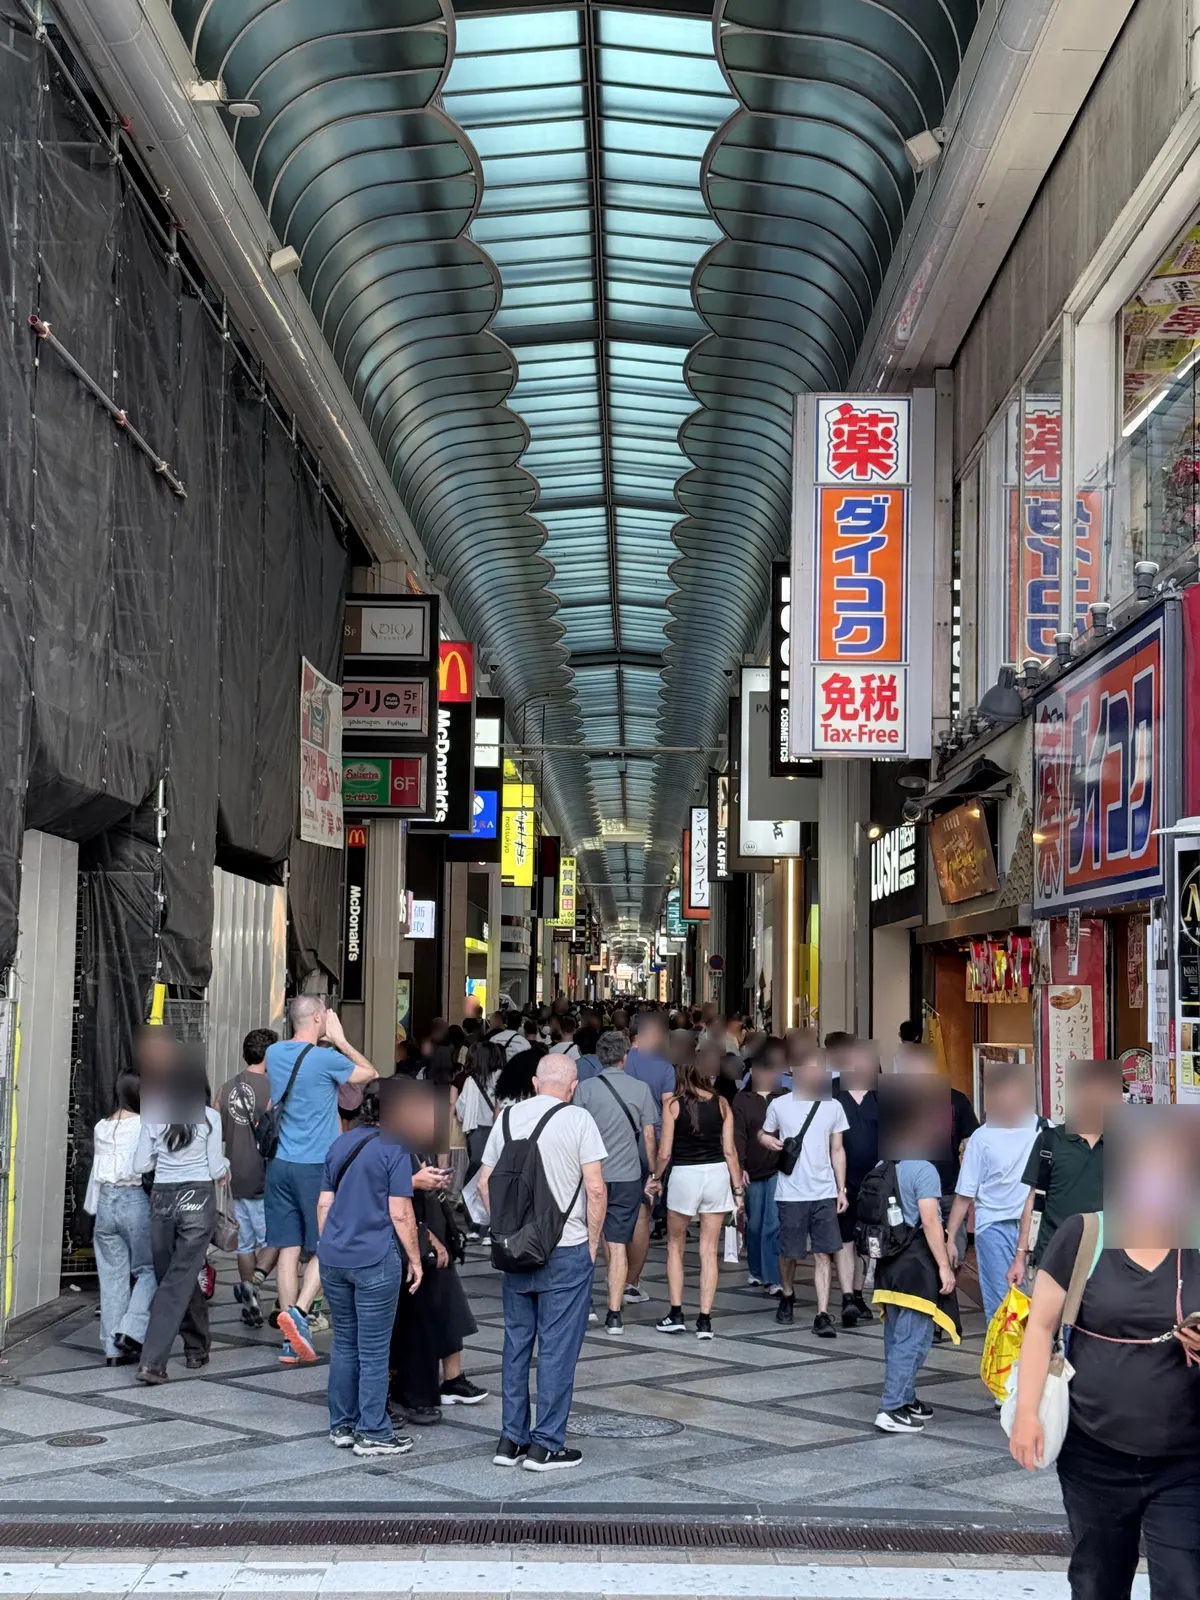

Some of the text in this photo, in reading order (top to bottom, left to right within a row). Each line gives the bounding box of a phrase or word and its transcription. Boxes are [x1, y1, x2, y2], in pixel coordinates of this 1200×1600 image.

[824, 403, 899, 480] 薬
[833, 495, 889, 656] ダイコク
[344, 625, 356, 636] 8F
[343, 688, 380, 712] プリ
[404, 690, 417, 700] 5F
[404, 704, 417, 714] 7F
[821, 672, 899, 723] 免税
[780, 708, 789, 763] COSMETICS
[821, 724, 899, 743] Tax-Free
[394, 777, 416, 791] 6F
[435, 709, 451, 822] McDonald's
[345, 793, 378, 801] サイゼリヤ
[694, 811, 707, 903] ジャパンライフ
[717, 841, 728, 877] CAFFÉ
[871, 827, 899, 902] LUSH
[348, 885, 361, 962] McDonald's
